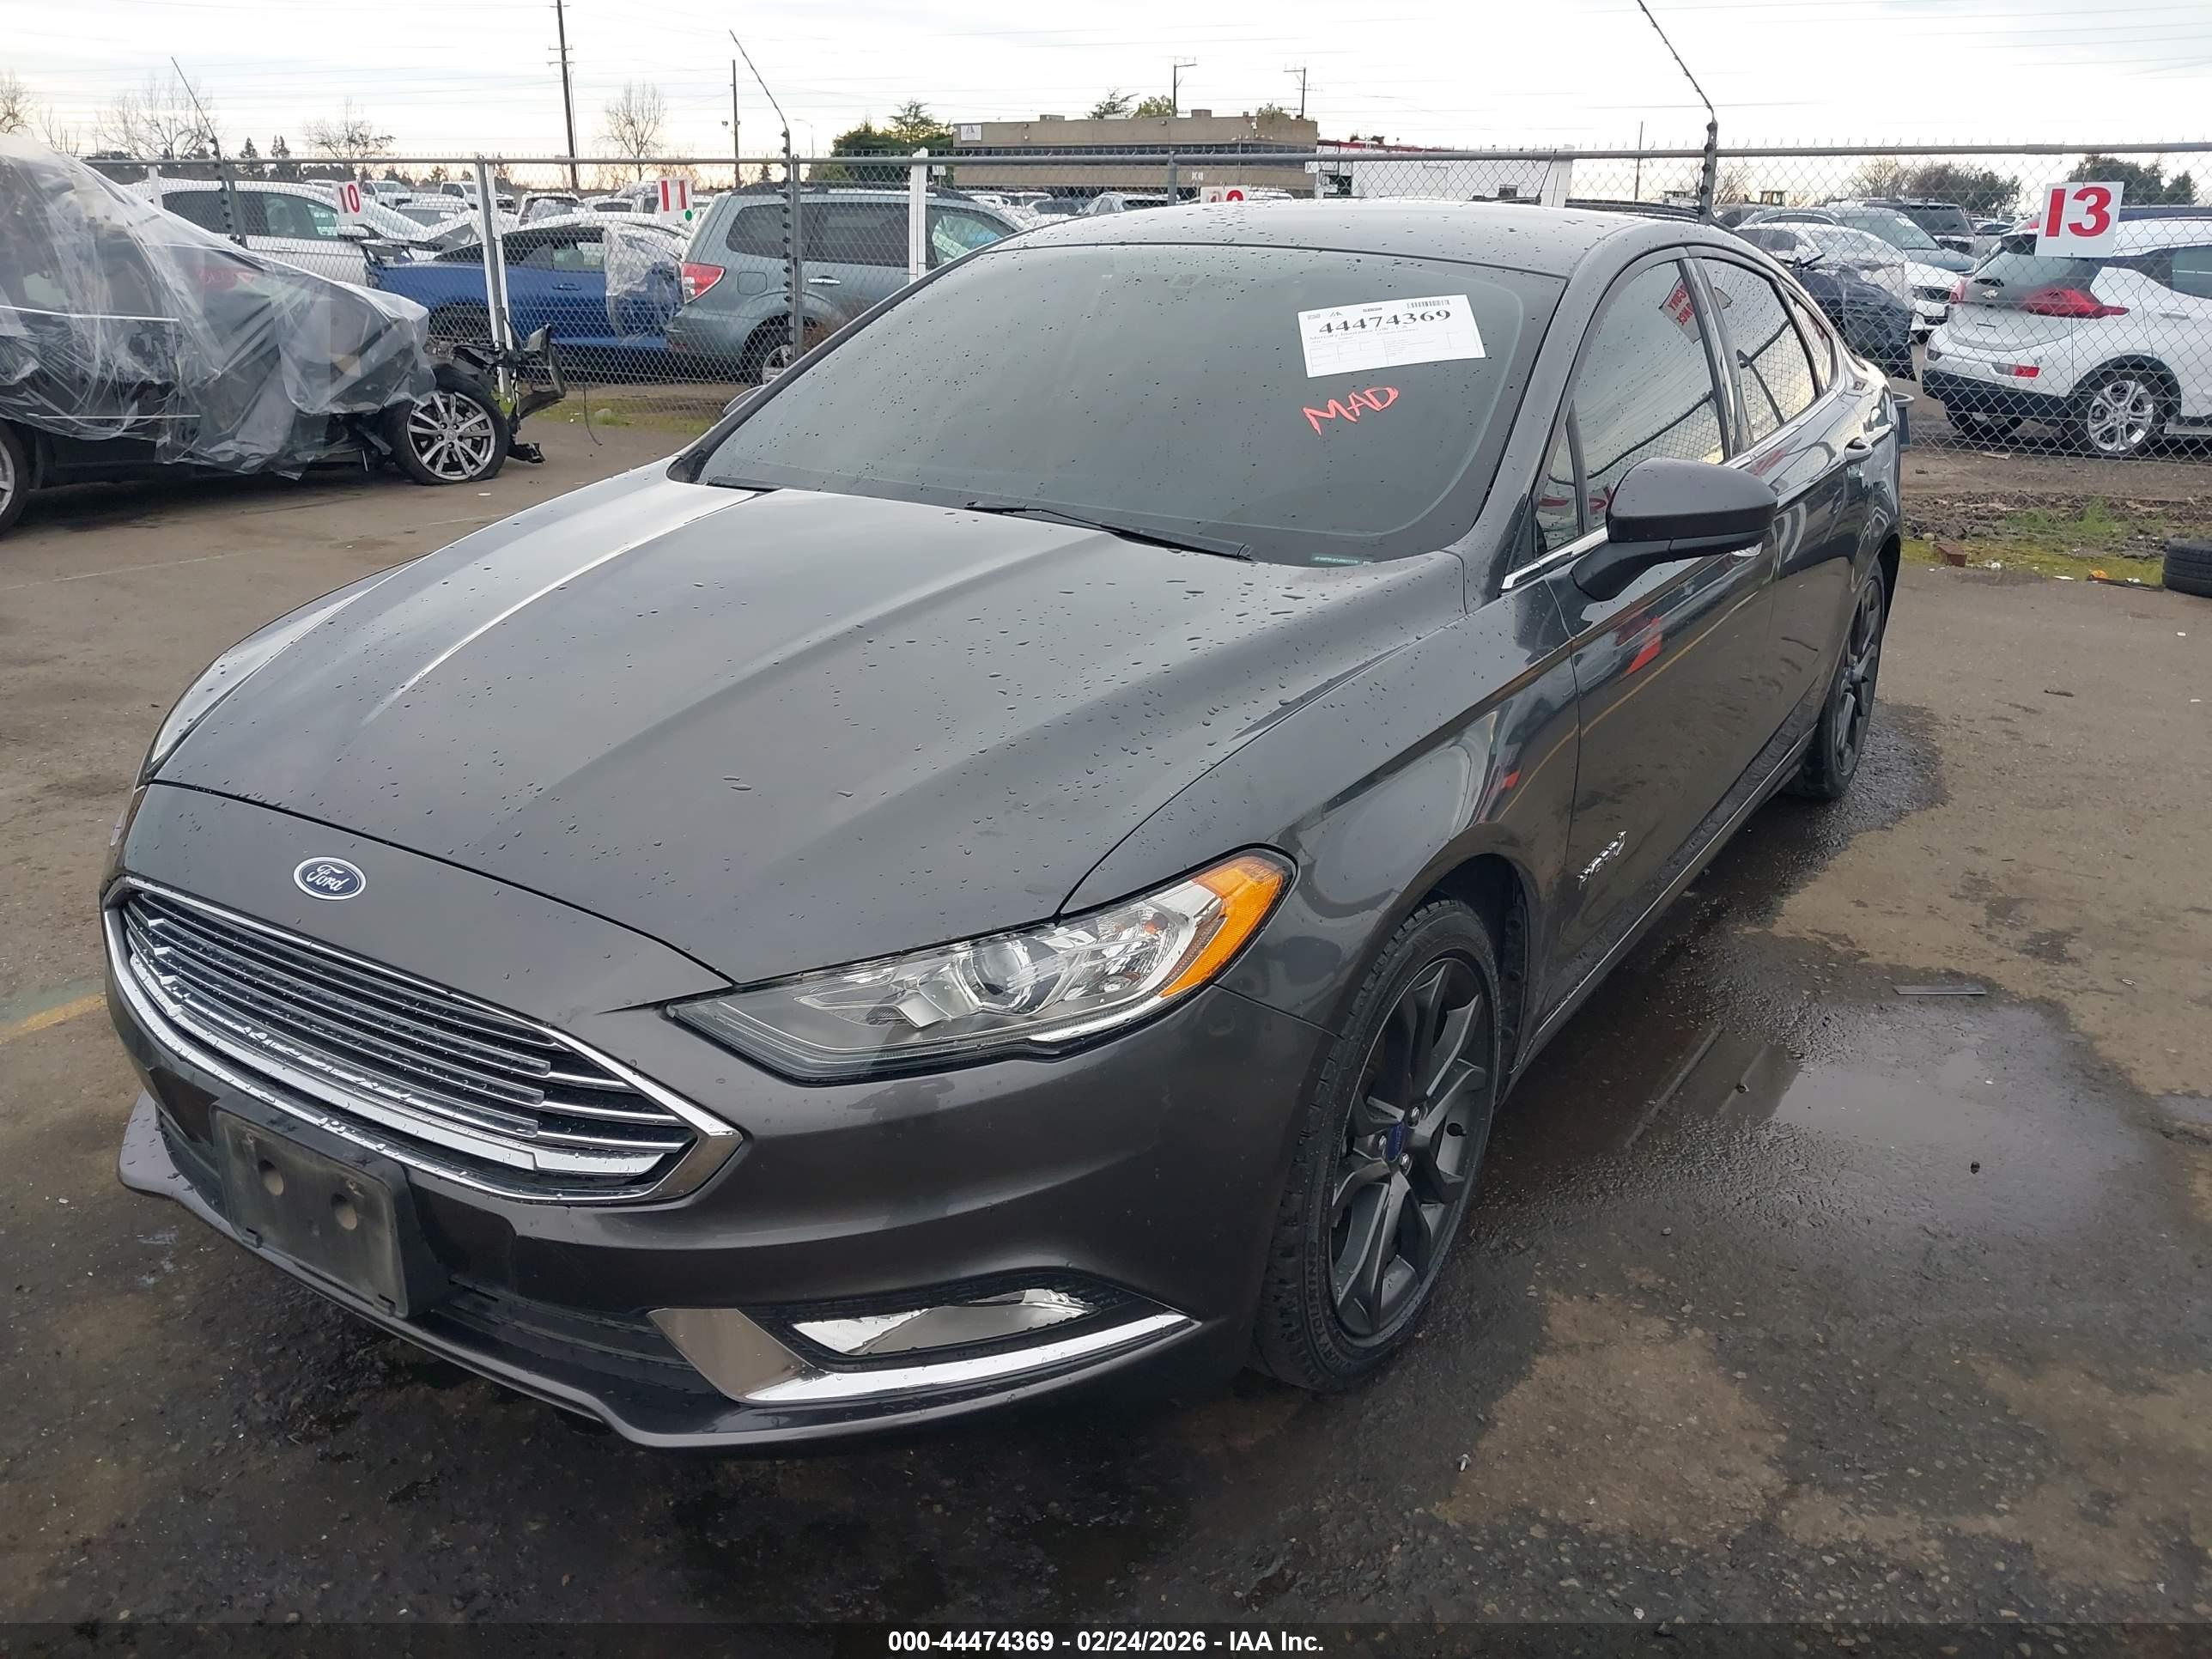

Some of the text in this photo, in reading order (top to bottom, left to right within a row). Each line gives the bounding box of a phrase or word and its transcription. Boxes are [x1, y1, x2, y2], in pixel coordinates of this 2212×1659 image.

[338, 184, 361, 214] 10
[660, 179, 689, 211] 11
[2044, 186, 2112, 238] 13
[1319, 308, 1451, 334] 44474369
[1302, 385, 1400, 436] MAD
[306, 864, 350, 891] Ford
